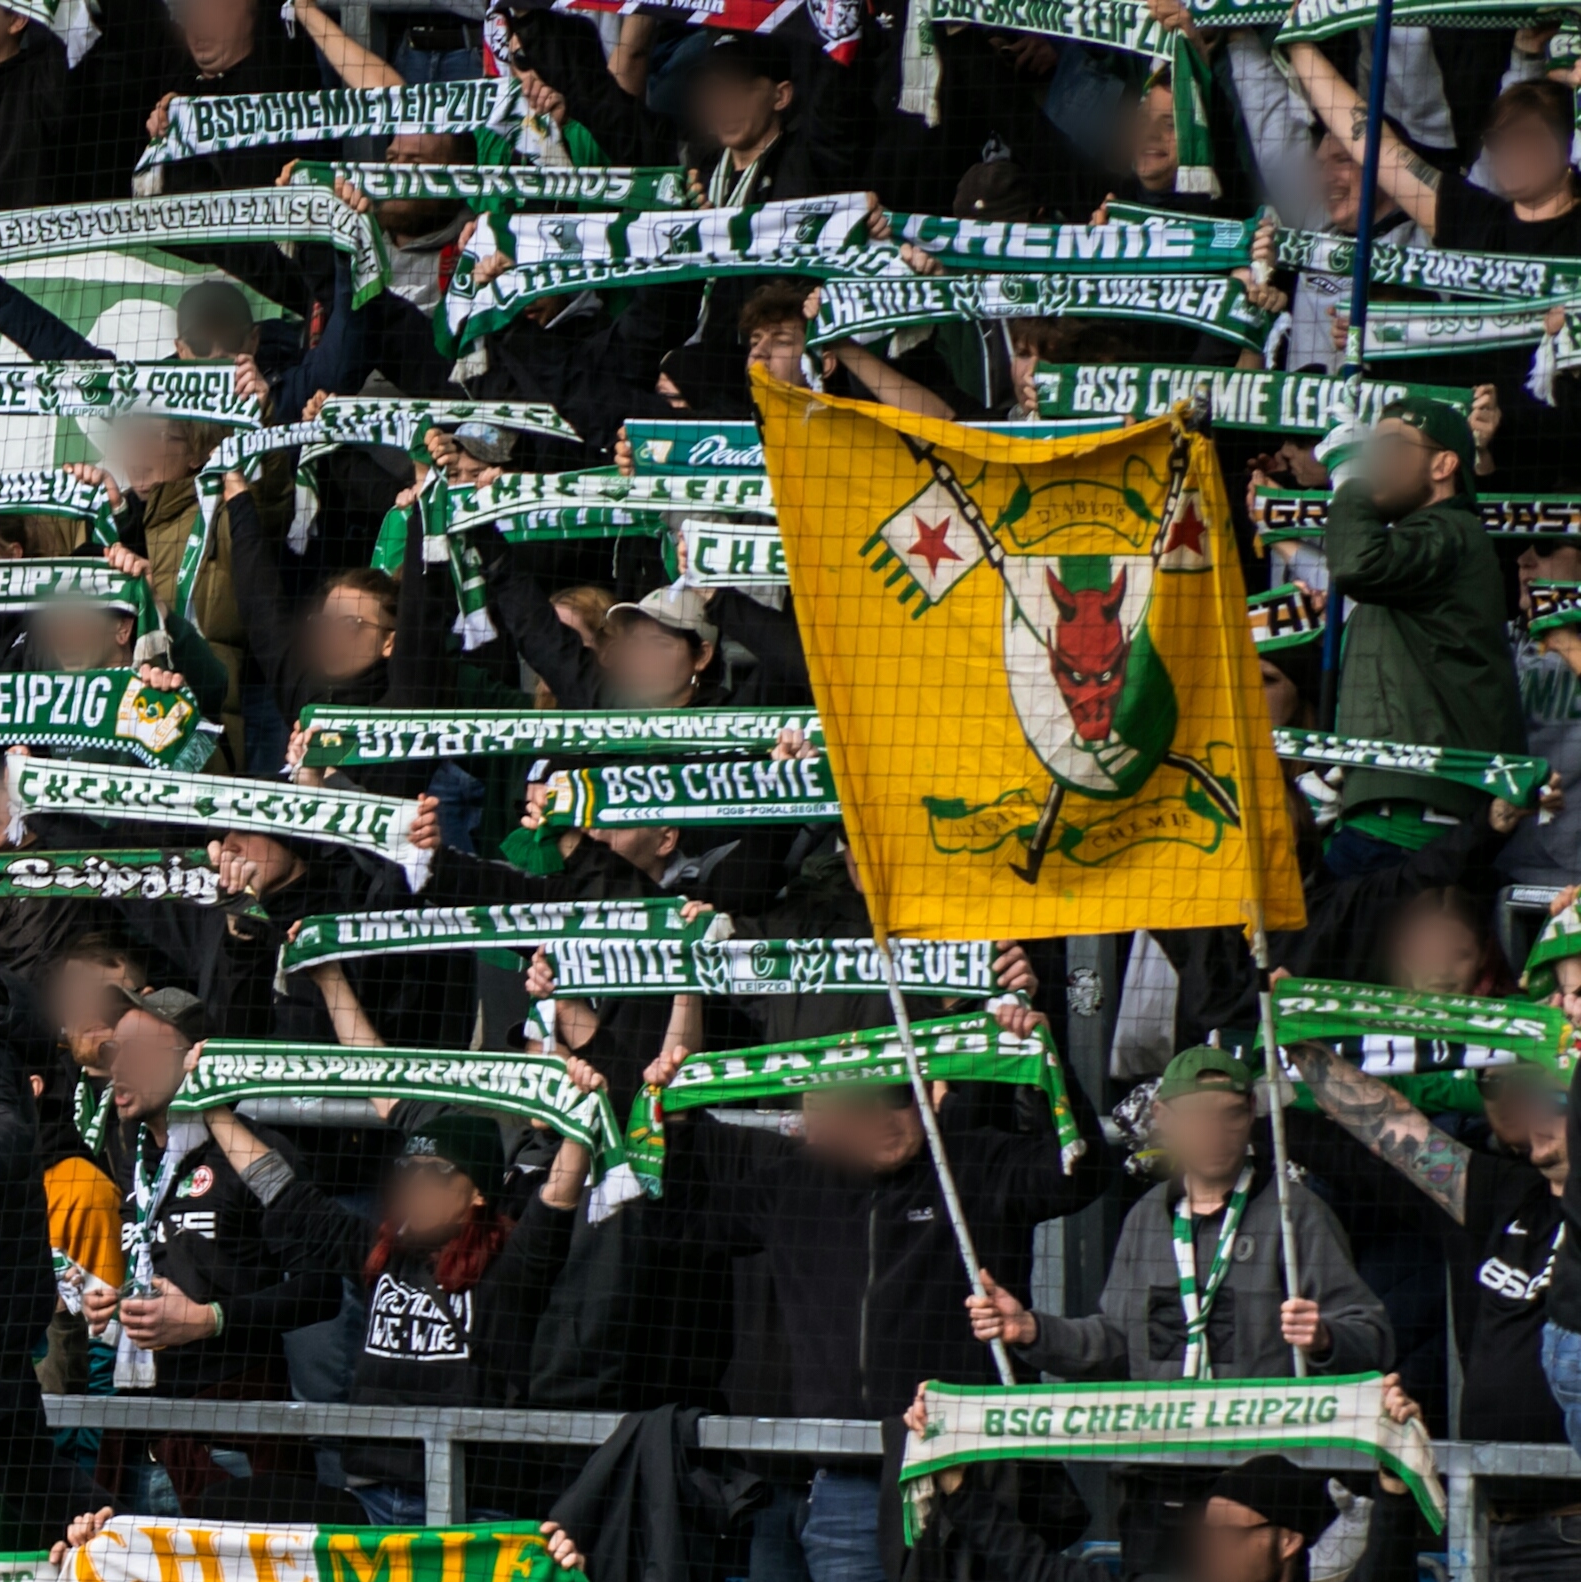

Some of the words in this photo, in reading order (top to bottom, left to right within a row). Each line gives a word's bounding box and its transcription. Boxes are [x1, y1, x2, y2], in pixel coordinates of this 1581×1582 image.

[195, 101, 259, 142] BSG
[261, 92, 382, 138] CHEMIE
[383, 82, 499, 125] LEIPZIG
[903, 214, 1195, 260] CHEMIE
[1403, 248, 1547, 298] FOREVER
[1073, 366, 1137, 412] BSG
[1148, 368, 1270, 425] CHEMIE
[688, 434, 765, 467] Deuts
[696, 536, 788, 576] CHE
[602, 764, 676, 804] BSG
[680, 756, 825, 801] CHEMIE
[336, 906, 482, 944] CHEMIE
[835, 940, 992, 988] FOREVER
[983, 1408, 1053, 1438] BSG
[1062, 1401, 1196, 1438] CHEMIE
[1202, 1395, 1339, 1429] LEIPZIG
